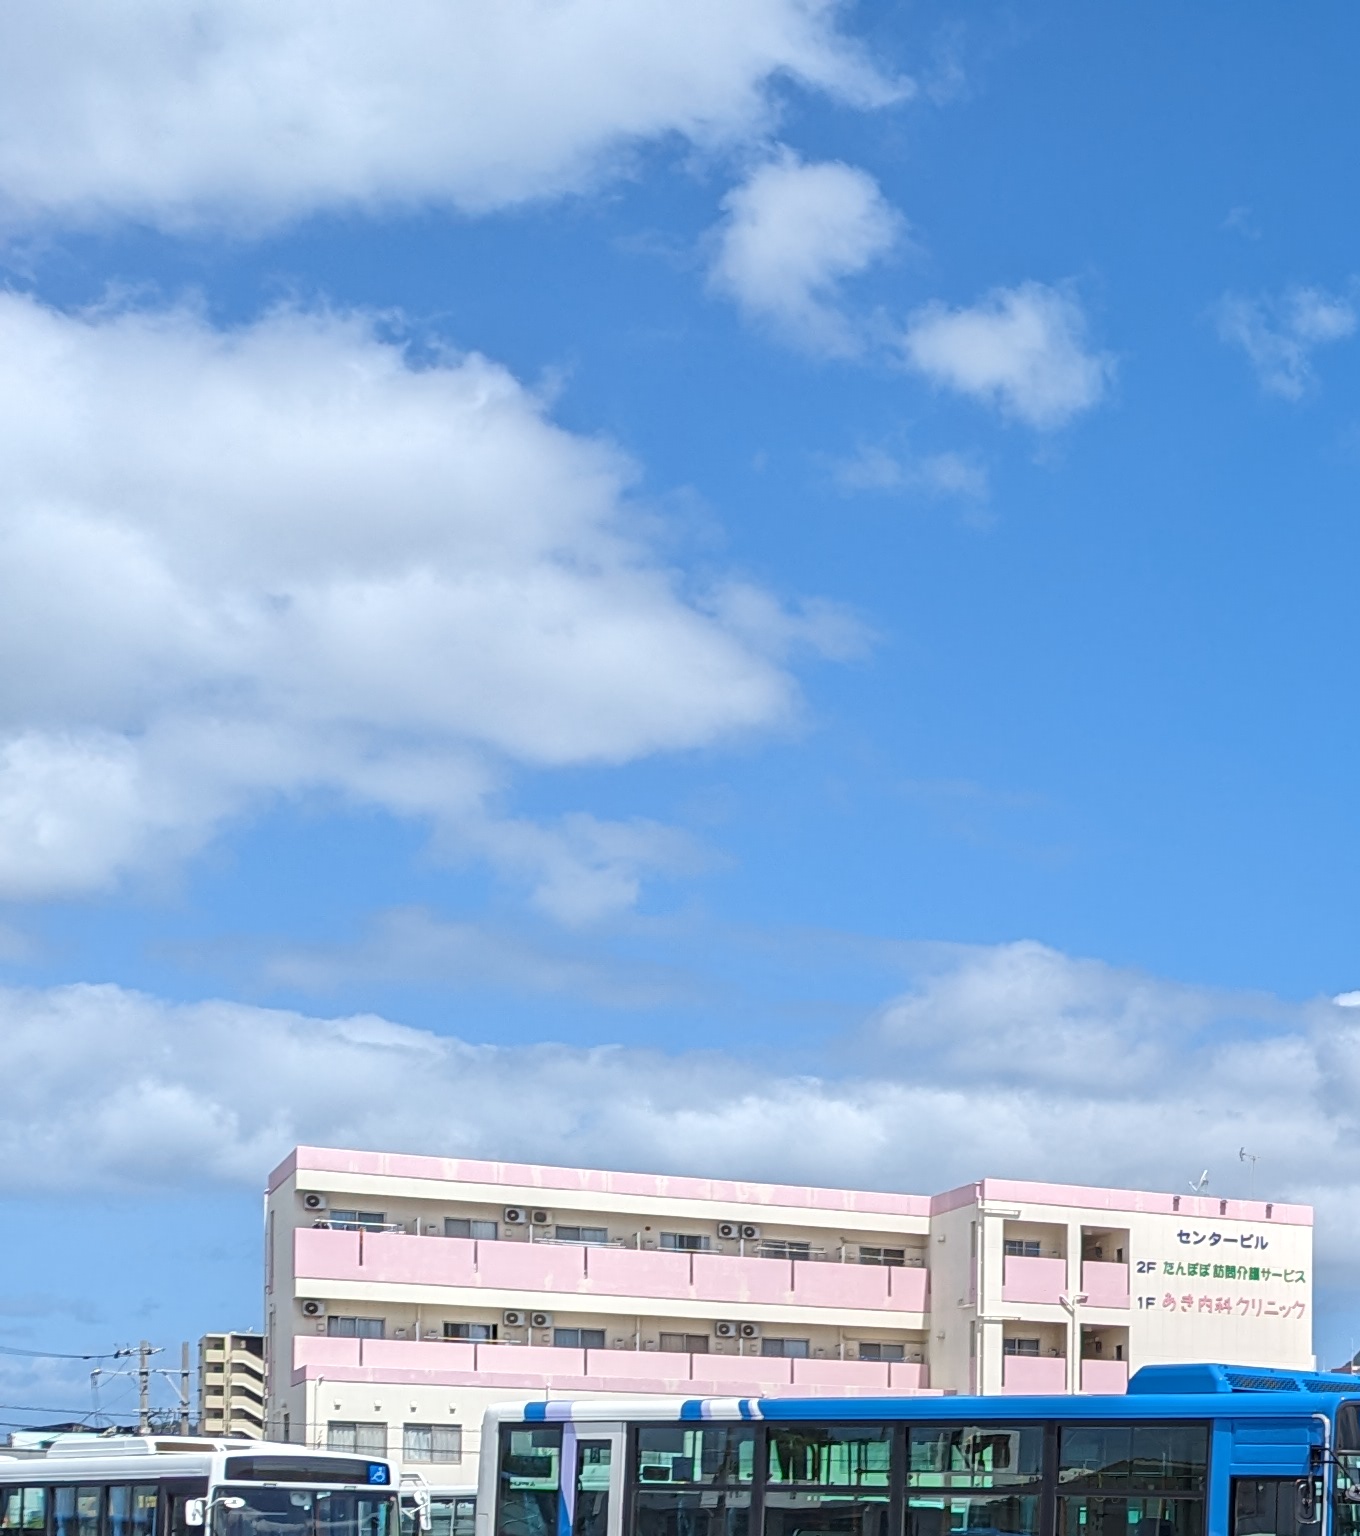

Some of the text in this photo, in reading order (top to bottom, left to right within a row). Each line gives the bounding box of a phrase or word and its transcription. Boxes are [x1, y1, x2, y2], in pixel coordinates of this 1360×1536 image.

[1177, 1229, 1269, 1250] センタービル
[1136, 1261, 1157, 1274] 2F
[1137, 1296, 1156, 1310] 1F
